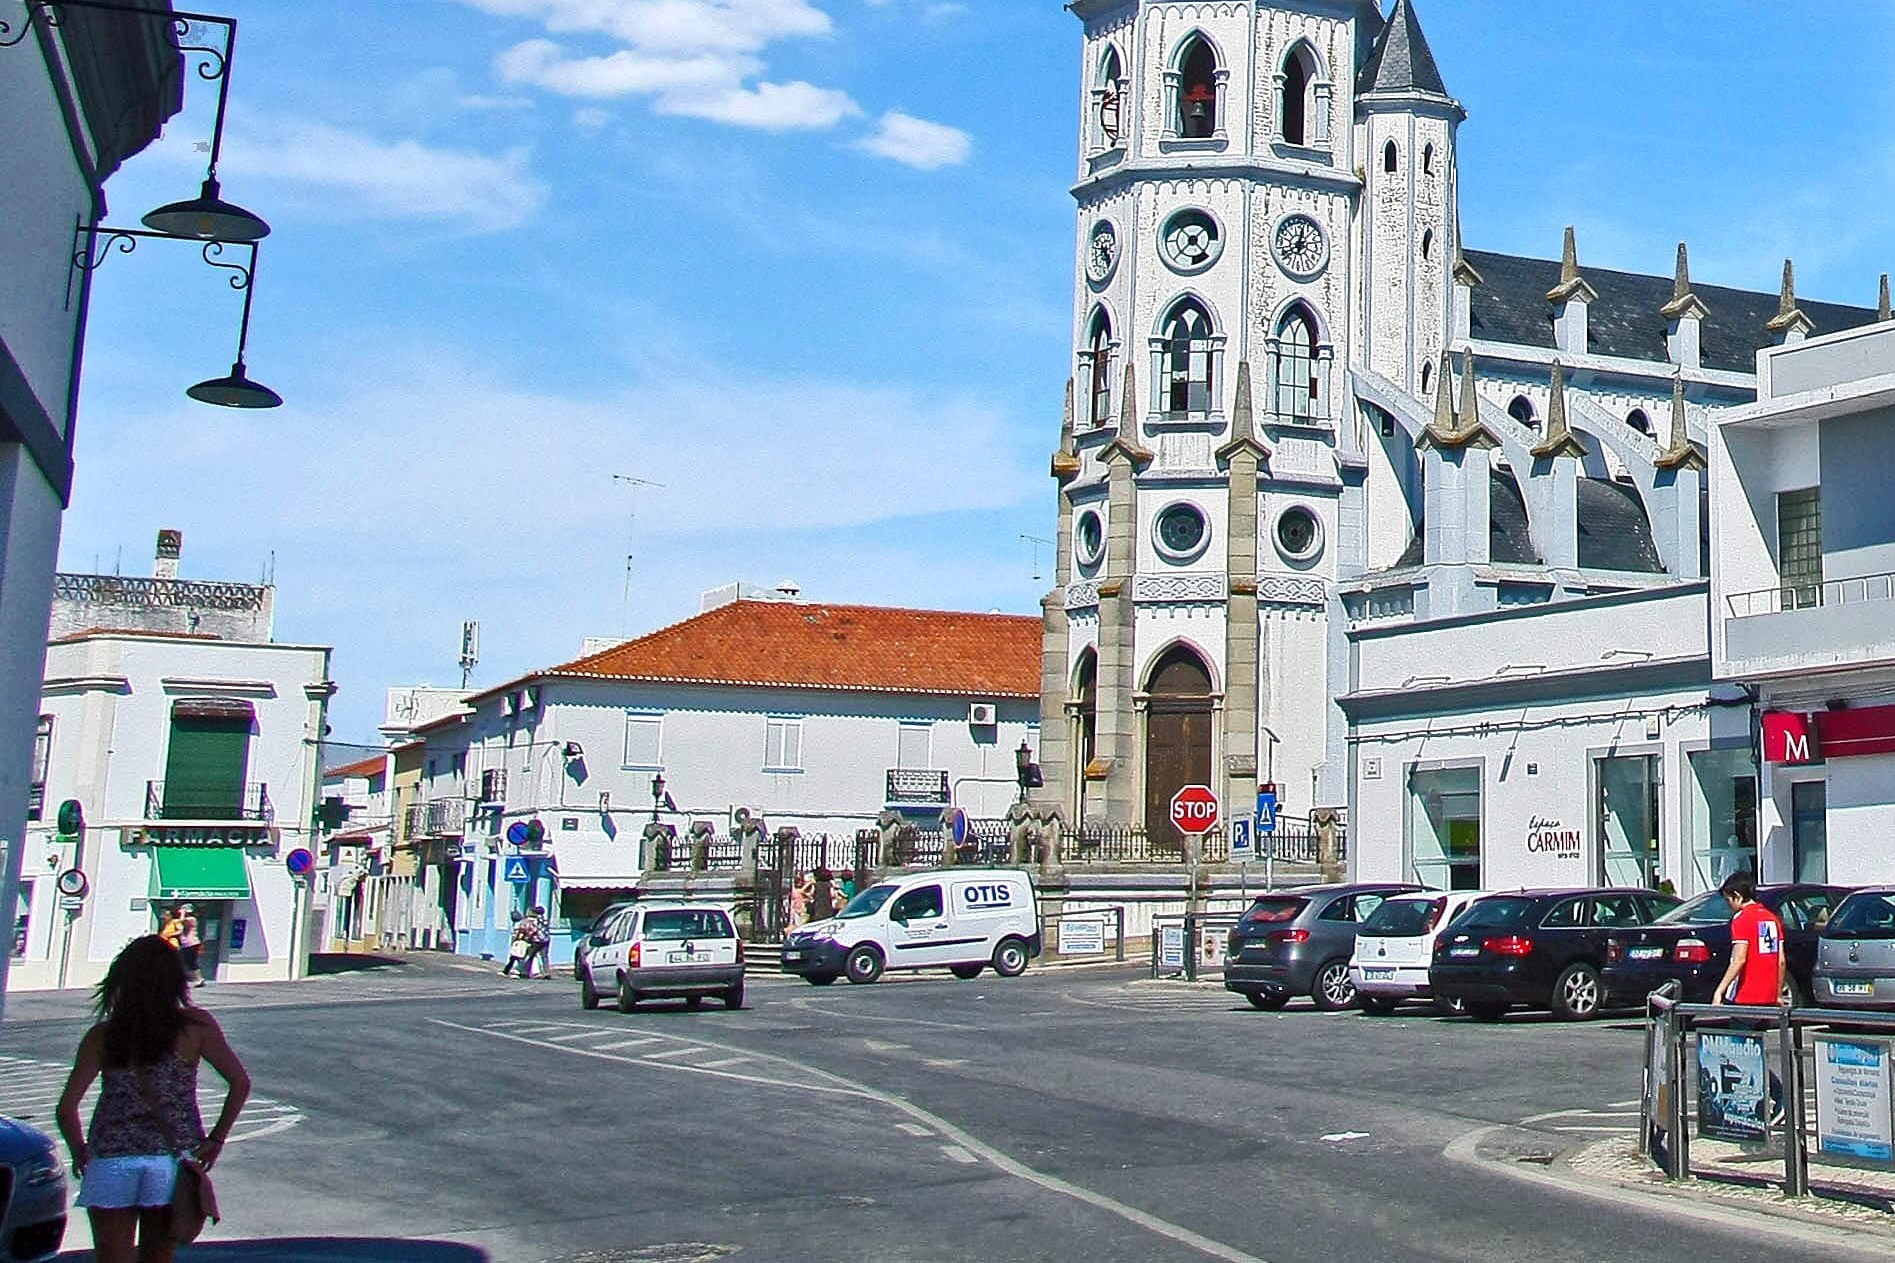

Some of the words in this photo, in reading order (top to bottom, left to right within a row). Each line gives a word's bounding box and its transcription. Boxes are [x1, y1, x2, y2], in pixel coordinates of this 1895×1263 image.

[1784, 730, 1810, 761] M
[1174, 801, 1217, 819] STOP
[1235, 823, 1243, 842] P
[1527, 831, 1580, 852] CARMIM
[964, 885, 1010, 902] OTIS
[1764, 926, 1774, 949] 4
